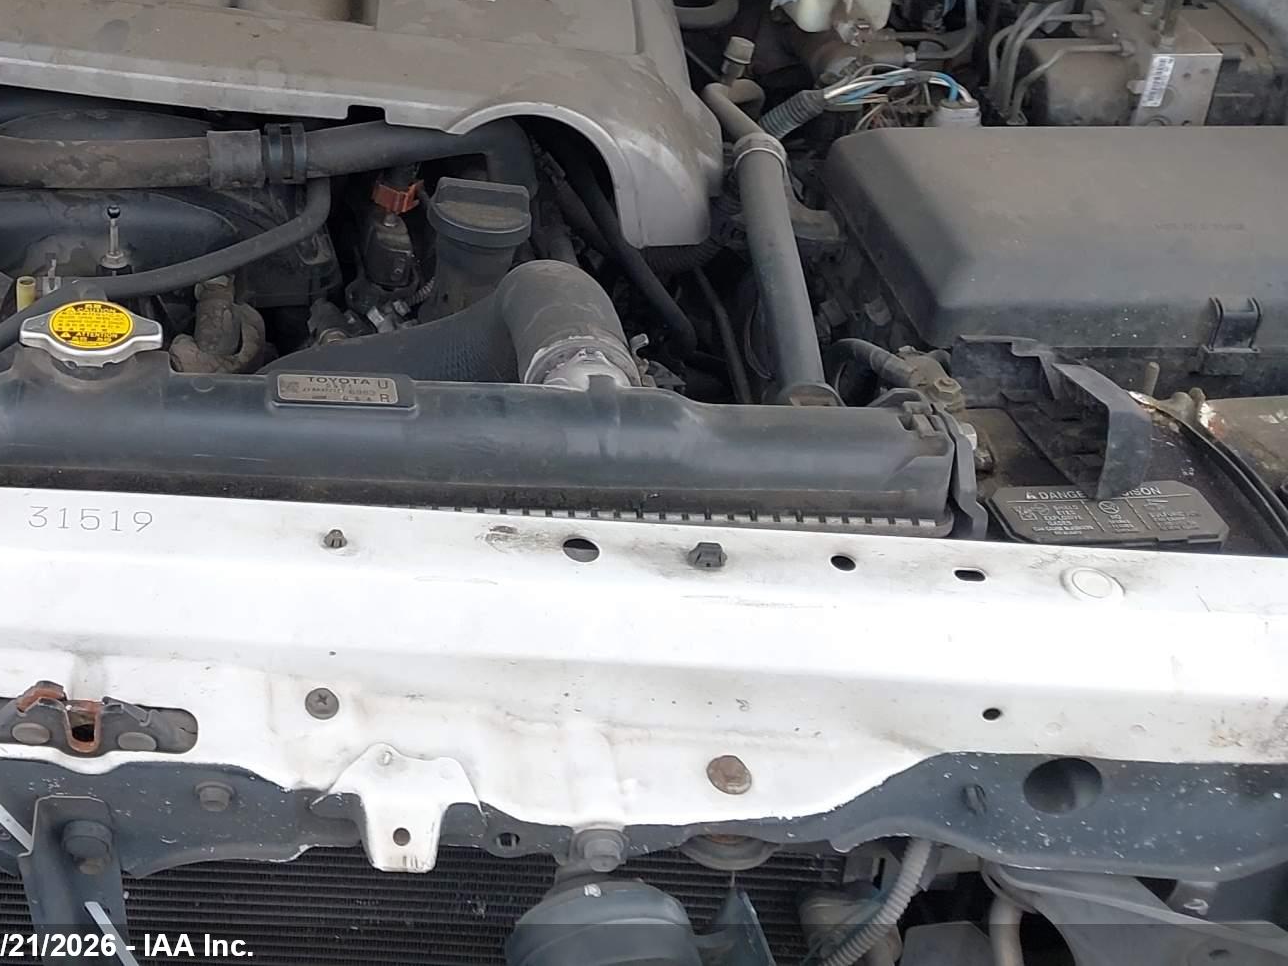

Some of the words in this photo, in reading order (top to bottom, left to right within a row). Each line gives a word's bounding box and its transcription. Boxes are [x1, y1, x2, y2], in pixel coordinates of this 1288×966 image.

[307, 377, 371, 385] TOYOTA
[1038, 490, 1088, 500] DANGE
[1121, 487, 1162, 497] ISON
[29, 505, 153, 533] 31519
